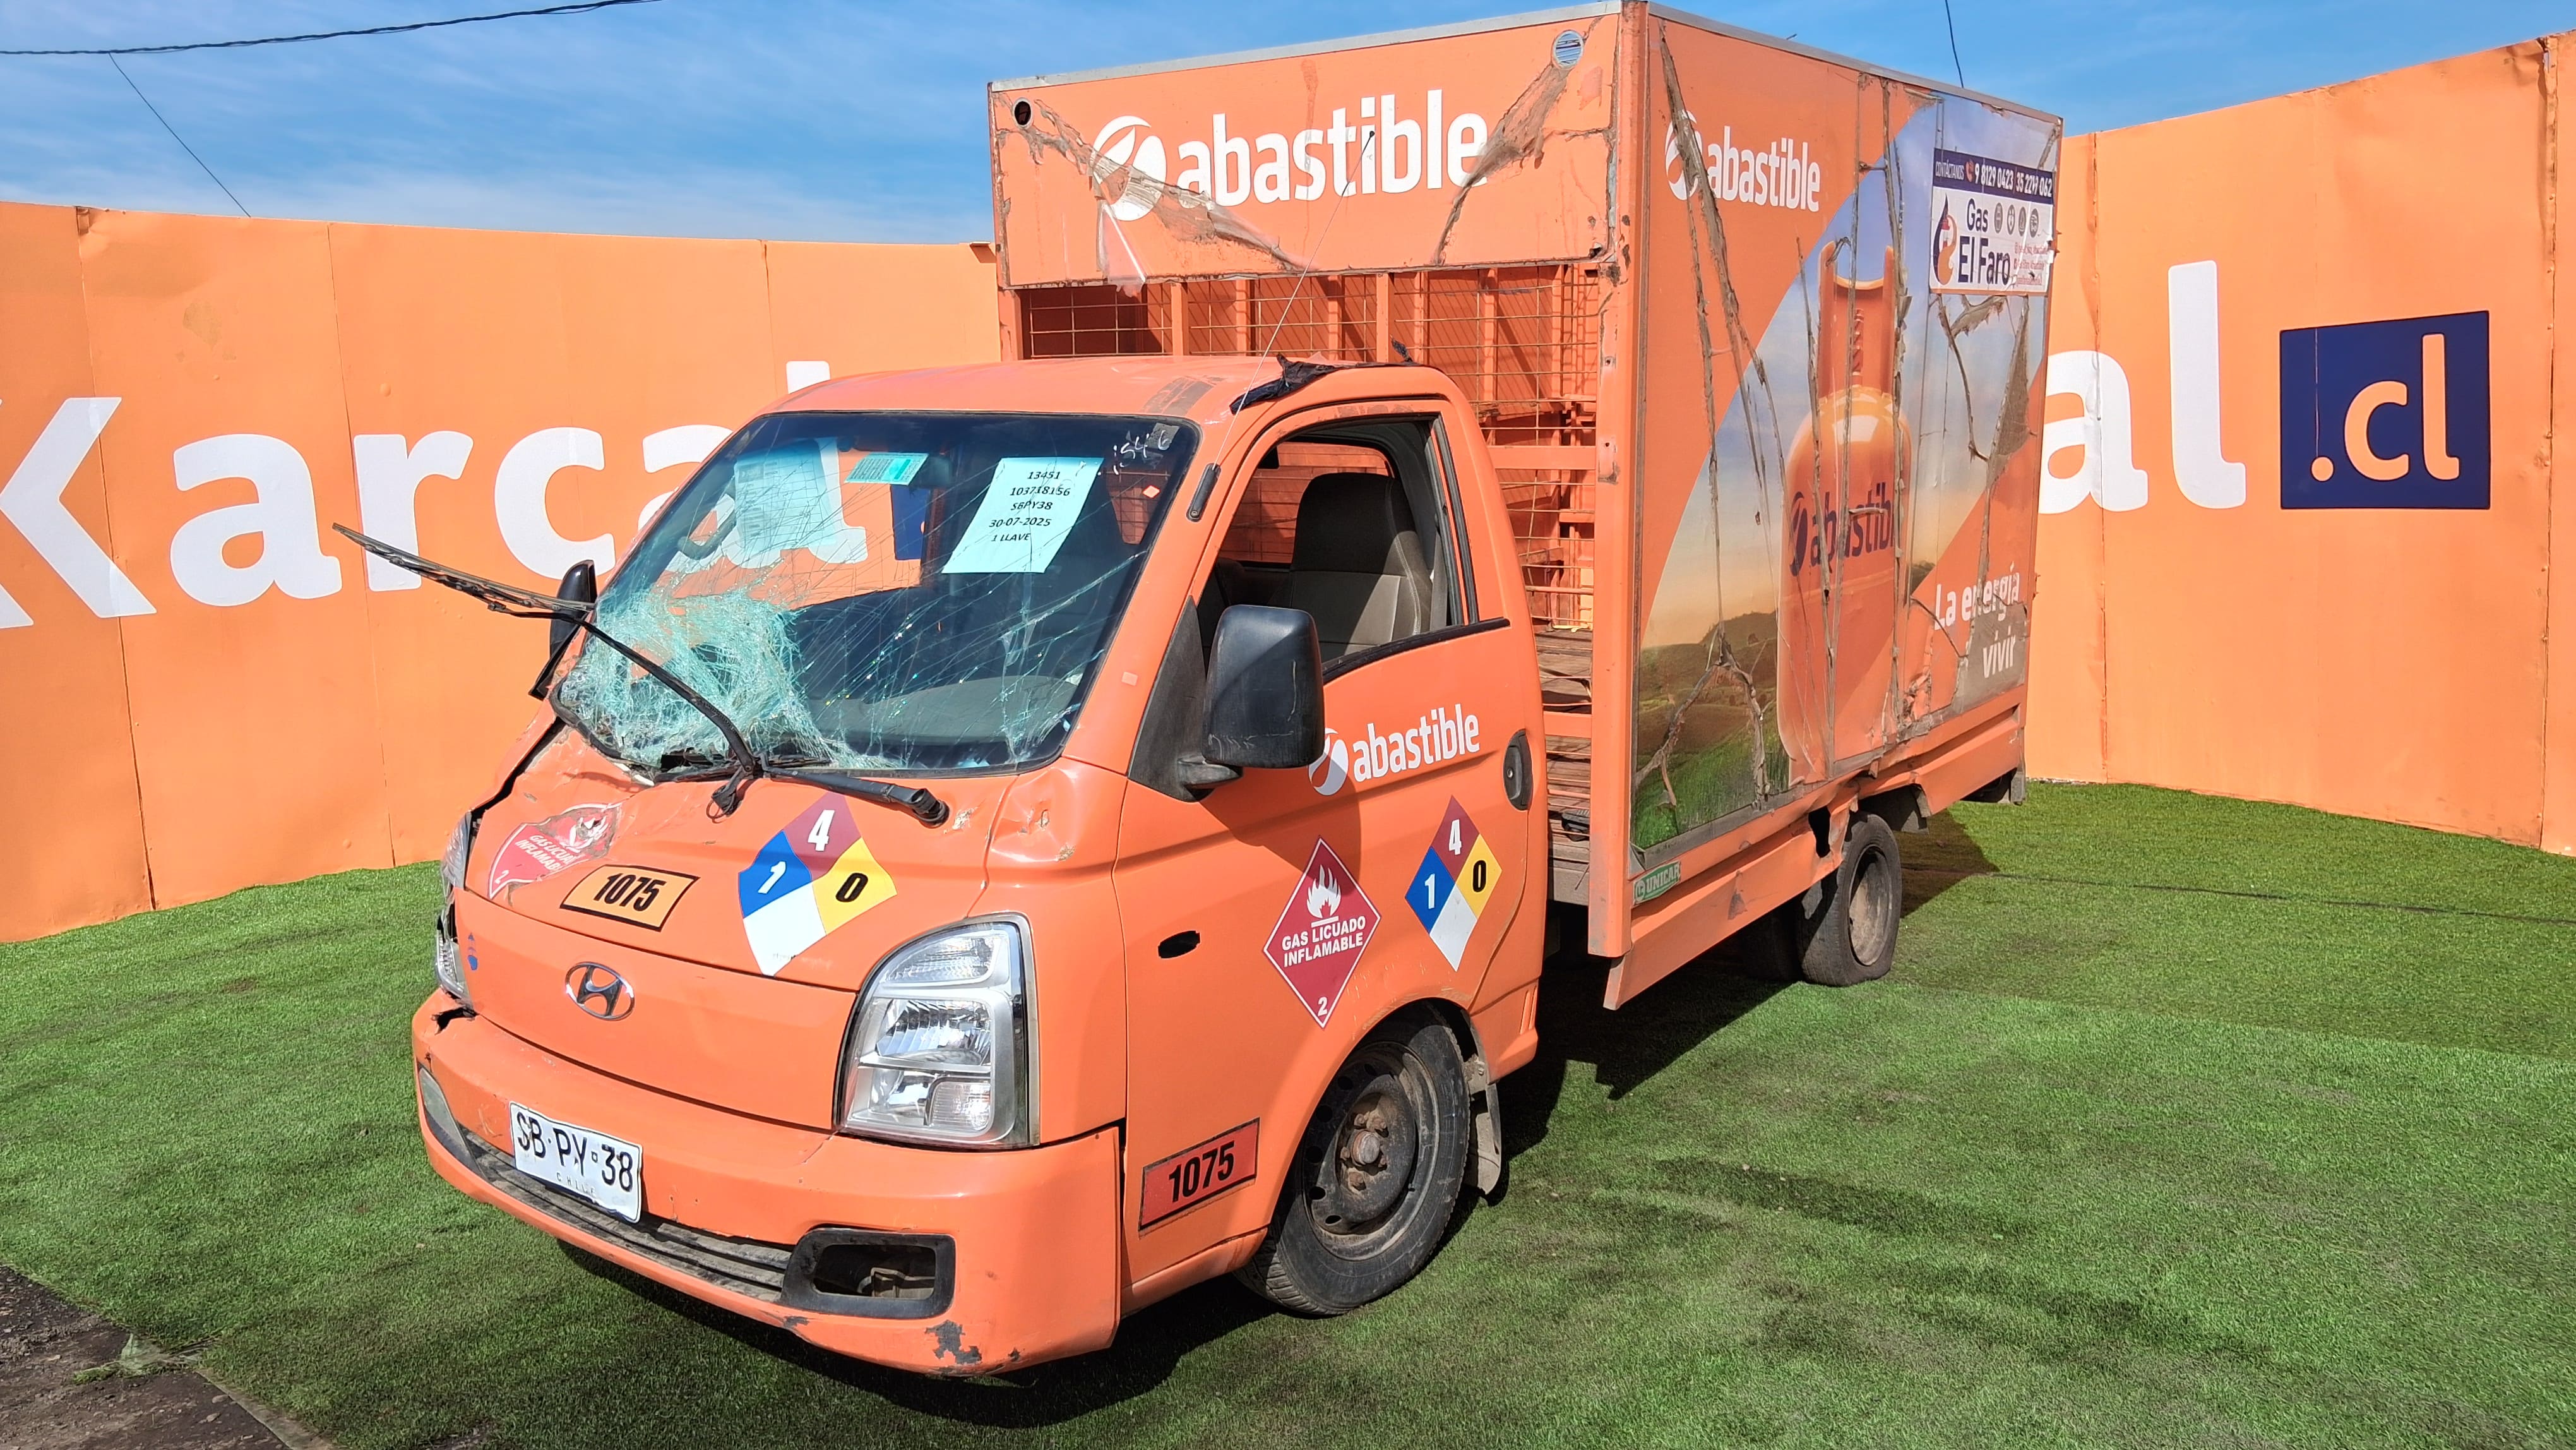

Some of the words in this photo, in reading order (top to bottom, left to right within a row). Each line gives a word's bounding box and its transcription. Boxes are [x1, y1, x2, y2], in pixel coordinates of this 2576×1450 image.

[1177, 89, 1488, 208] abastible
[1707, 126, 1820, 212] abastible
[1974, 163, 1980, 184] 9
[1981, 164, 1996, 187] 8129
[1997, 167, 2014, 190] 0423
[2016, 172, 2024, 193] 35
[1967, 198, 1988, 232] Gas
[1958, 236, 1975, 283] El
[1977, 237, 2010, 285] Faro
[1010, 486, 1071, 496] 103718156
[1027, 471, 1061, 480] 13451
[989, 517, 1052, 528] 30-07-2025
[1011, 501, 1053, 511] SBPY38
[1000, 533, 1031, 542] LLAVE
[1934, 584, 1957, 630] La
[1353, 704, 1481, 782] abastible
[530, 835, 553, 847] GAS
[808, 810, 835, 851] 4
[1448, 819, 1461, 856] 4
[495, 870, 509, 884] 2
[593, 873, 667, 912] 1075
[758, 861, 787, 894] 1
[835, 873, 868, 902] 0
[1424, 873, 1436, 909] 1
[1472, 860, 1487, 893] 0
[1646, 863, 1680, 893] UNICAR
[1282, 929, 1308, 950] GAS
[1312, 916, 1366, 943] LICUADO
[1284, 932, 1364, 968] INFLAMABLE
[1318, 997, 1328, 1017] 2
[1169, 1141, 1235, 1203] 1075
